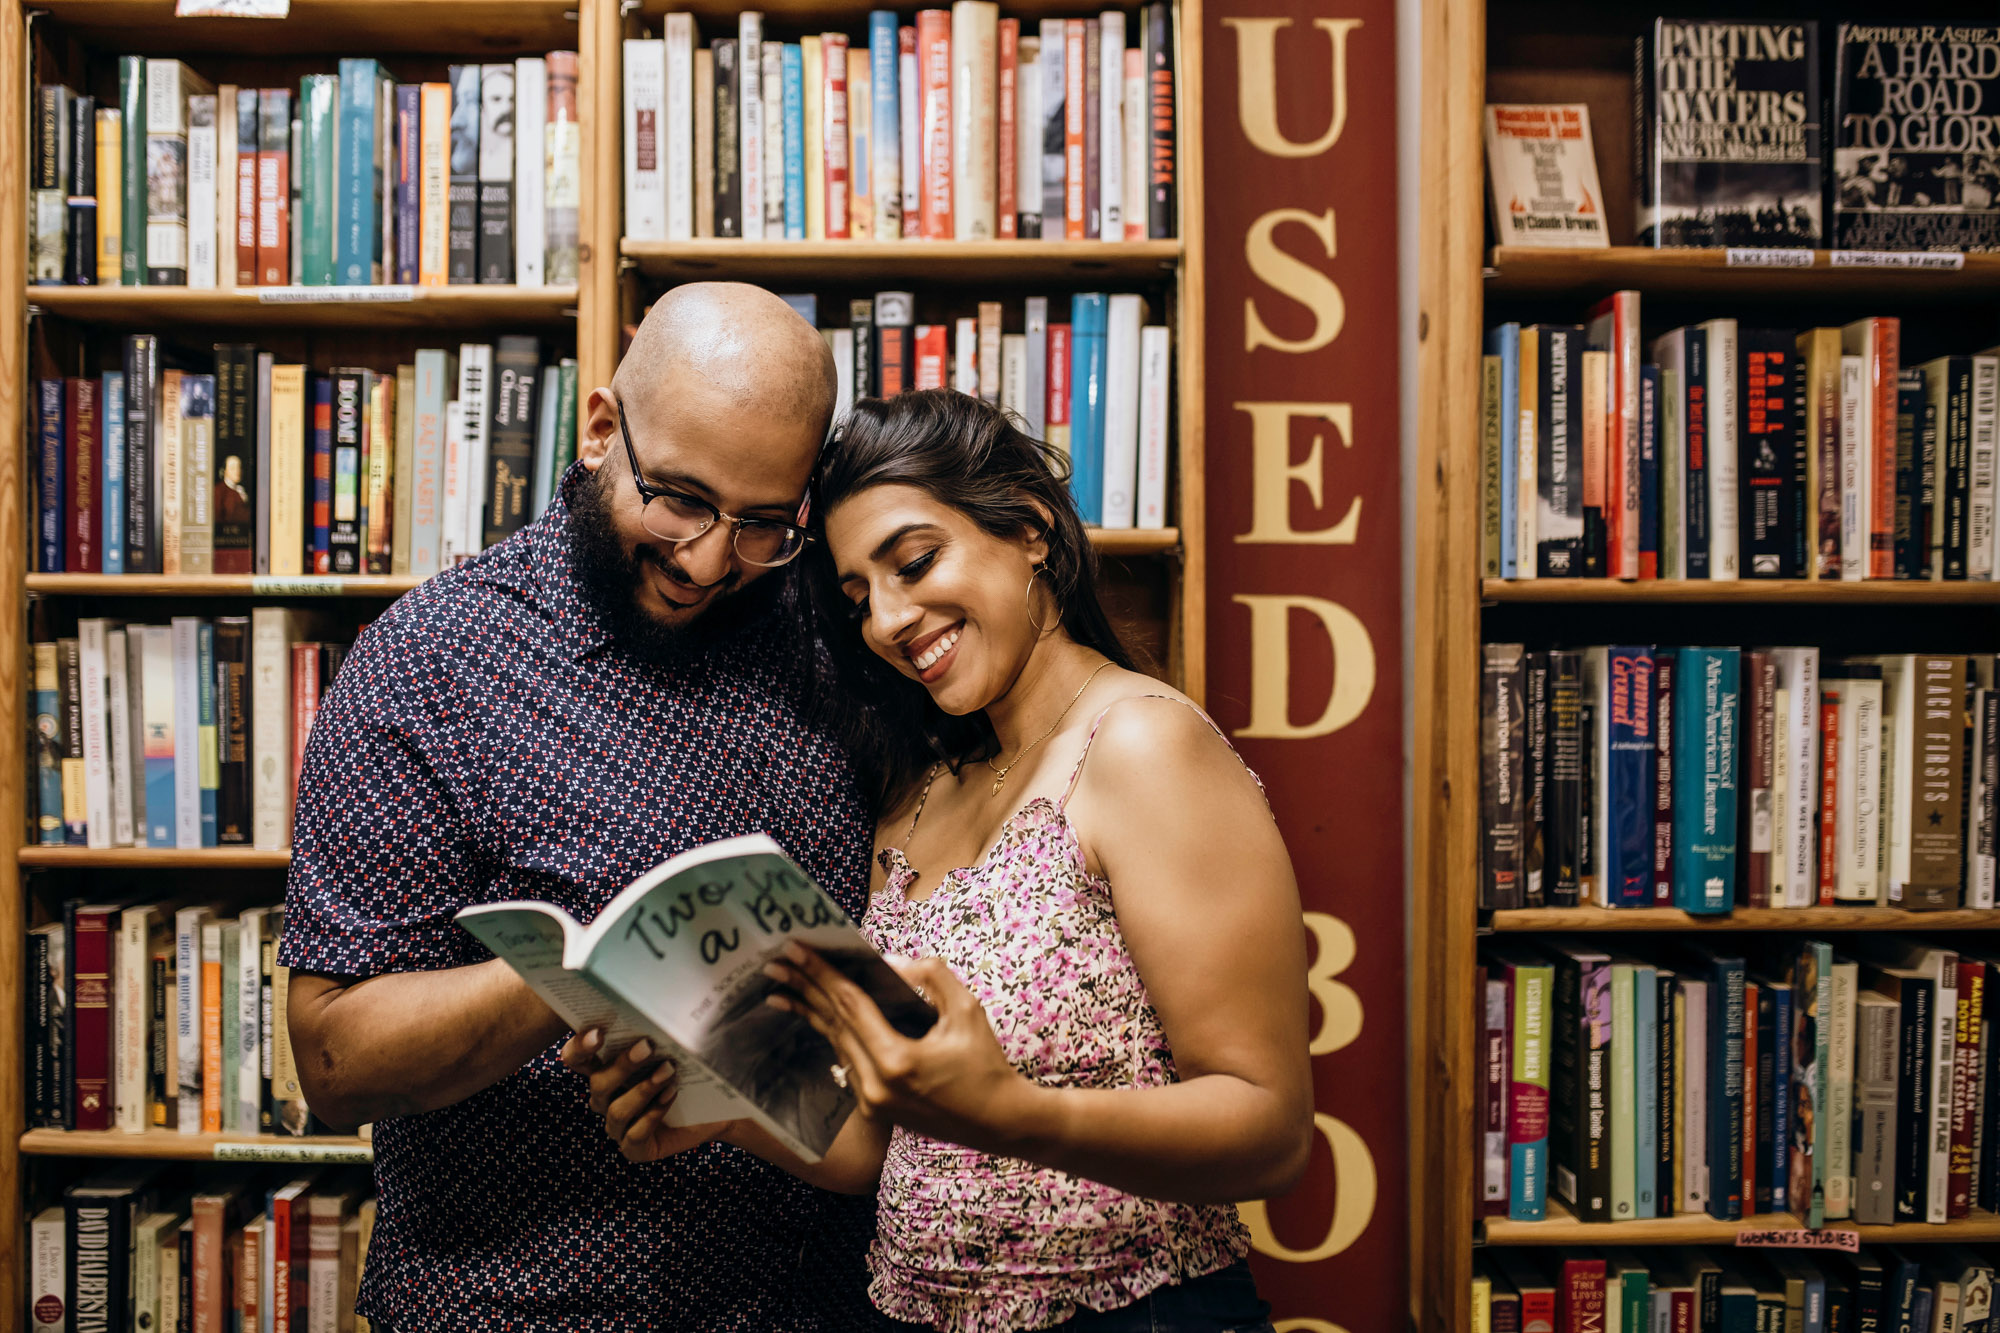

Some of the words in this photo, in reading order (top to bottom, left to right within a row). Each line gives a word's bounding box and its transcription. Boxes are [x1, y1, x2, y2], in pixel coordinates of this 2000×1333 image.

[1662, 24, 1805, 61] PARTING
[1847, 25, 1918, 43] ARTHUR
[932, 40, 950, 83] THE
[1662, 57, 1737, 92] THE
[1856, 44, 1886, 79] A
[1896, 43, 2000, 80] HARD
[1152, 70, 1173, 132] UNION
[1662, 90, 1807, 126] WATERS
[1881, 79, 1983, 117] ROAD
[930, 88, 950, 215] WATERGATE
[1768, 125, 1804, 143] THE
[1844, 113, 1897, 151] TO
[1900, 114, 2000, 154] GLOR
[1152, 138, 1173, 184] JACK
[1732, 252, 1760, 266] BLACK
[855, 328, 867, 342] The
[1051, 331, 1064, 354] THE
[1051, 358, 1064, 390] HUNGRY
[1221, 18, 1378, 741] USED
[1551, 332, 1569, 392] PARTING
[496, 369, 515, 426] Cheney
[516, 376, 533, 421] Lynne
[1051, 393, 1064, 422] YEARS
[1551, 394, 1568, 425] THE
[1749, 352, 1767, 434] ROBESON
[1768, 352, 1784, 434] PAUL
[417, 413, 436, 454] BAD
[1521, 410, 1534, 480] FREEDOM
[1551, 427, 1568, 482] WATERS
[417, 459, 436, 525] HABITS
[1802, 656, 1812, 682] WES
[1926, 660, 1951, 721] BLACK
[1496, 678, 1511, 749] LANGSTON
[1610, 656, 1634, 728] Ground
[1633, 656, 1655, 737] Common
[1801, 686, 1812, 729] MOORE
[1718, 692, 1736, 775] Masterpieces
[1497, 752, 1511, 805] HUGHES
[1720, 776, 1736, 790] of
[1923, 733, 1950, 803] FIRSTS
[1704, 773, 1721, 836] Literature
[1796, 833, 1808, 877] MOORE
[624, 878, 735, 960] Two
[700, 926, 740, 965] a
[745, 890, 848, 936] Bed
[1525, 978, 1541, 1036] VISIONARY
[1956, 998, 1969, 1043] DOWD
[1970, 976, 1984, 1043] MAUREEN
[1524, 1039, 1541, 1079] WOMEN
[1939, 1017, 1953, 1062] PUTTING
[1938, 1064, 1951, 1105] WOMEN
[1967, 1048, 1979, 1078] ARE
[1952, 1047, 1968, 1131] NECESSARY?
[1966, 1081, 1978, 1111] MEN
[1937, 1107, 1949, 1118] IN
[1935, 1120, 1949, 1154] PLACE
[1525, 1148, 1536, 1174] ANDREA
[1524, 1175, 1536, 1202] BARNET
[77, 1207, 109, 1249] DAVID
[1740, 1232, 1798, 1245] WOMEN'S
[1802, 1232, 1856, 1248] STUDIES
[49, 1246, 61, 1278] DAVID
[276, 1261, 288, 1317] ENGINES
[1944, 1312, 1953, 1330] NOT
